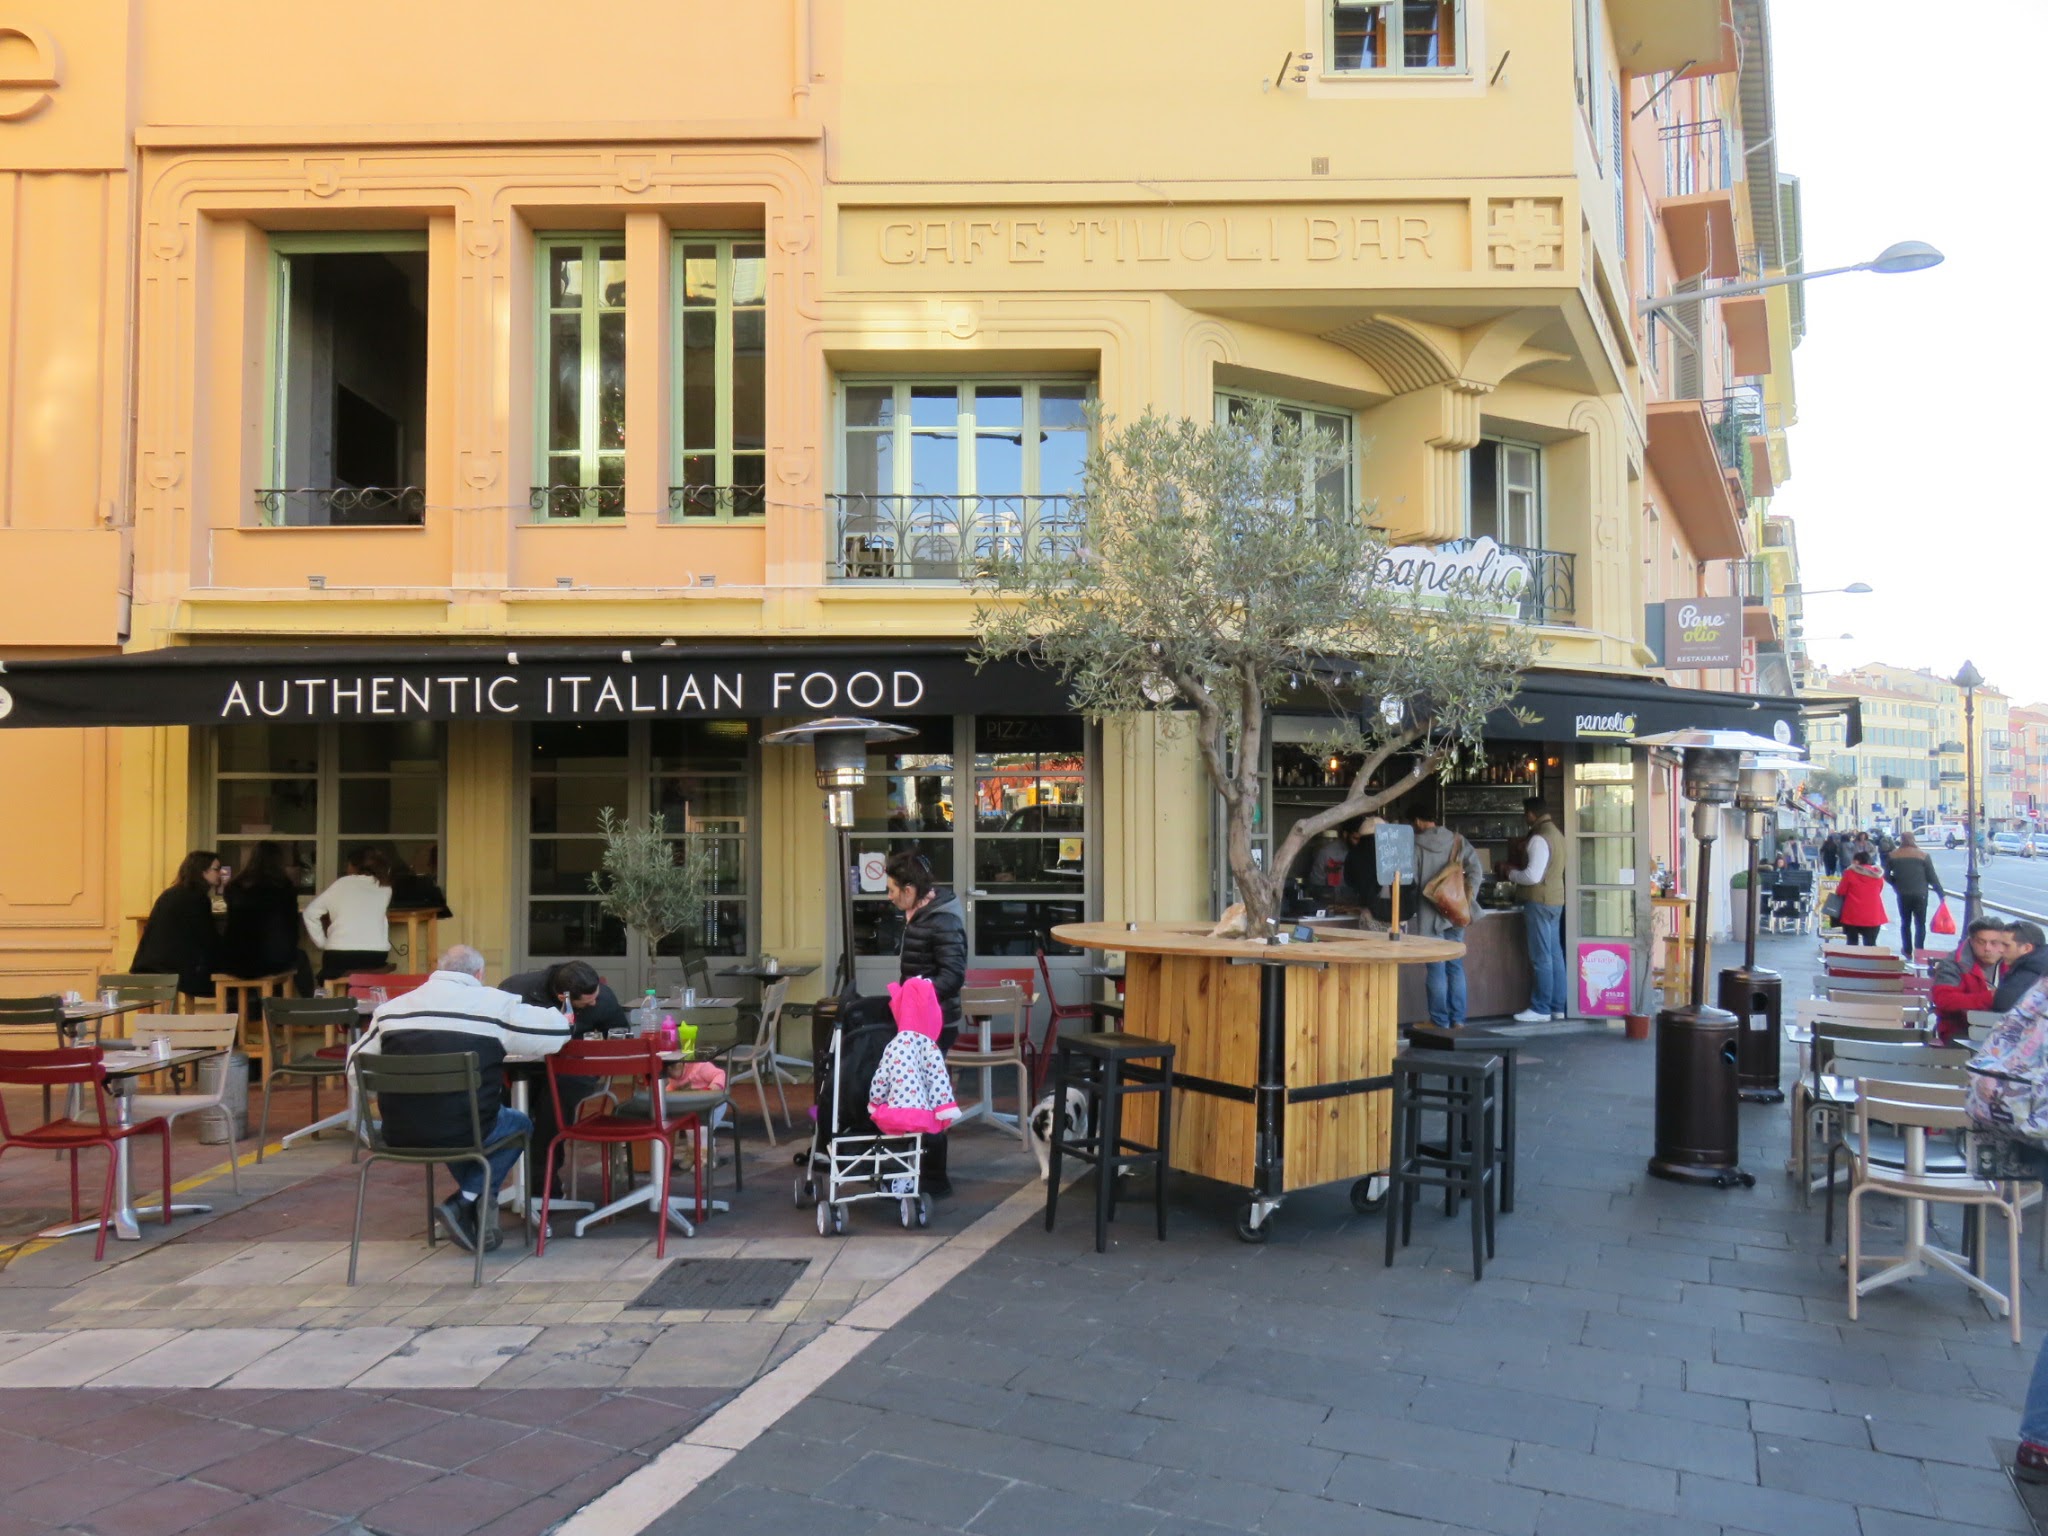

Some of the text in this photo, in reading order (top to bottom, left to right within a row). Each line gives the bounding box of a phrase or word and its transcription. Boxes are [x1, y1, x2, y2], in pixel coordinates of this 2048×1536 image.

[878, 218, 1046, 265] CAFE
[1304, 216, 1433, 262] BAR
[1678, 605, 1725, 629] Pane
[1683, 624, 1720, 643] olio
[1676, 655, 1729, 663] RESTAURANT
[221, 671, 924, 717] AUTHENTIC ITALIAN FOOD
[1575, 711, 1635, 738] paneolio
